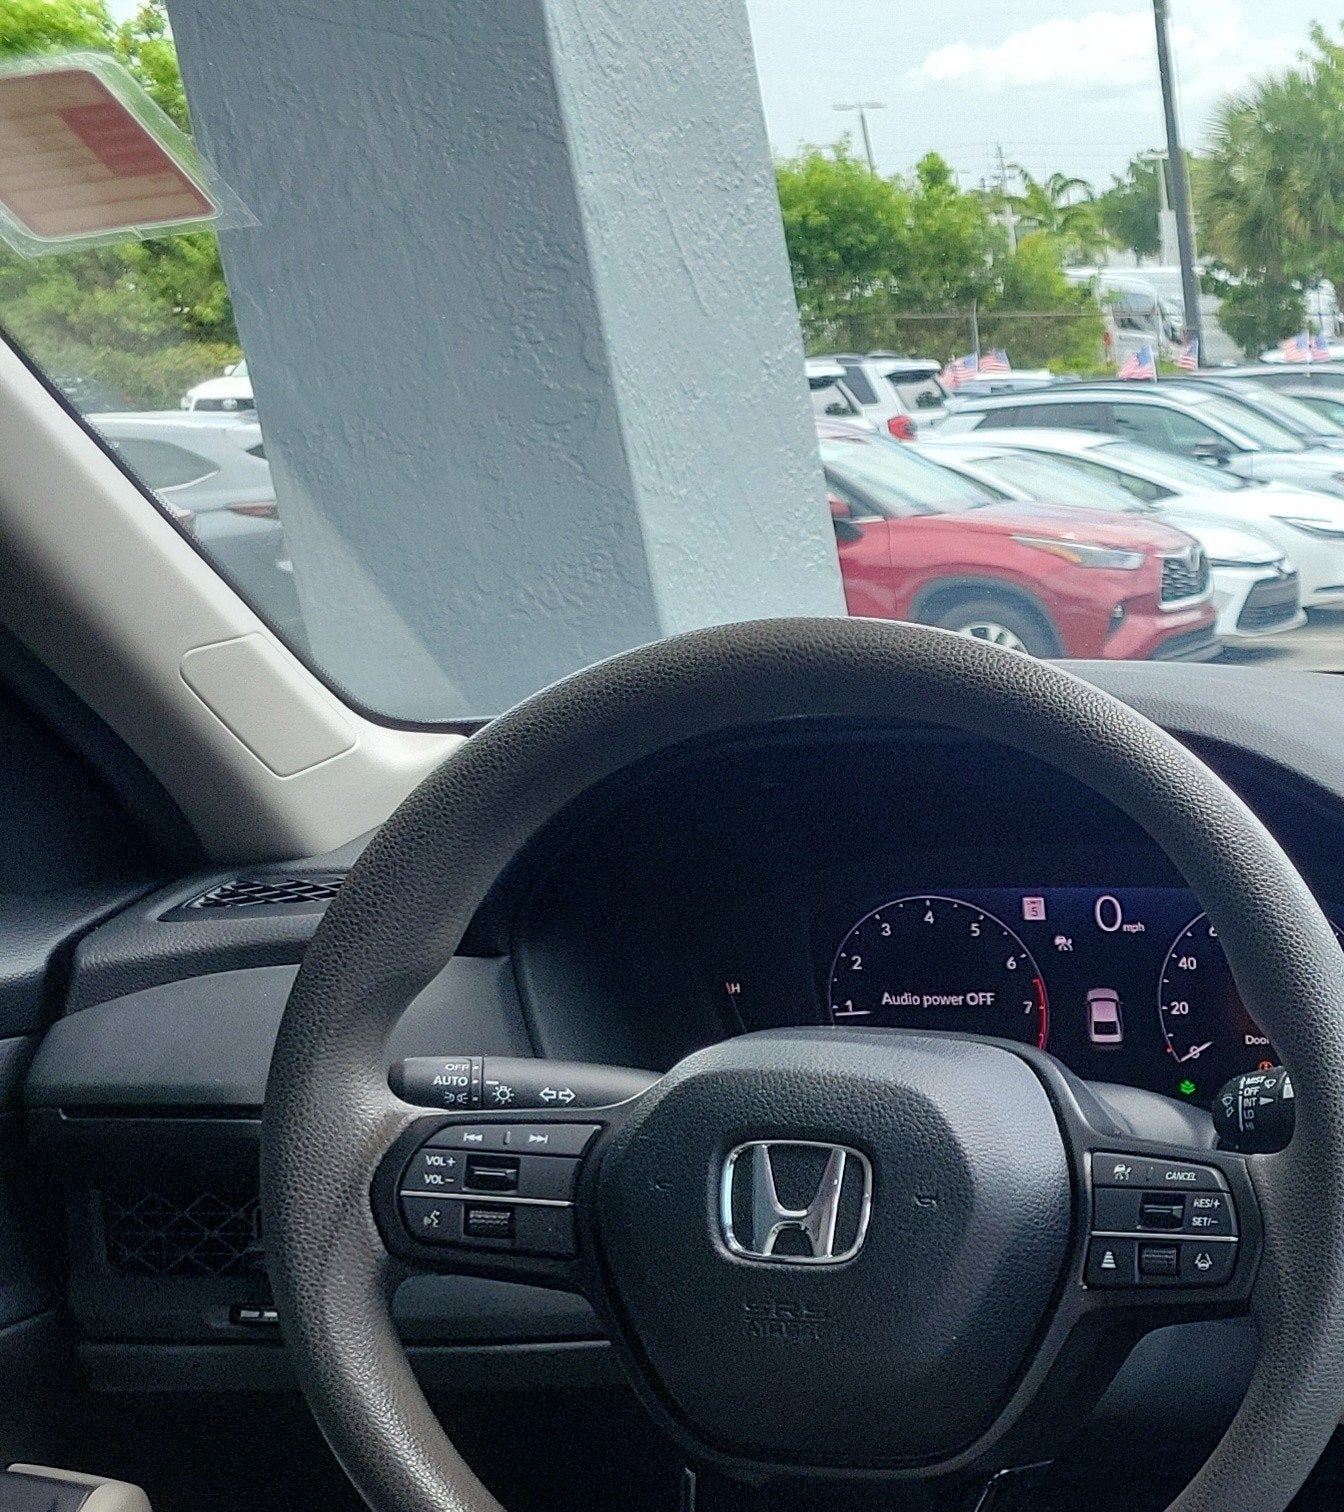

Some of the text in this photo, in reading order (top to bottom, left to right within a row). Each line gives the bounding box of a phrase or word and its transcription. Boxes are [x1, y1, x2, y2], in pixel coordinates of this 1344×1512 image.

[923, 911, 934, 924] 4
[1095, 895, 1145, 934] 0 mph
[881, 923, 892, 936] 3
[970, 924, 981, 937] 5
[851, 957, 863, 970] 2
[1006, 956, 1017, 970] 6
[1178, 957, 1197, 970] 40
[844, 1000, 853, 1012] 1
[881, 992, 995, 1009] Audio power OFF
[1023, 1001, 1033, 1014] 7
[1170, 1001, 1189, 1015] 20
[445, 1063, 469, 1071] OFF
[433, 1076, 468, 1086] AUTO
[1243, 1086, 1260, 1096] OFF
[1243, 1097, 1257, 1107] INT
[1165, 1171, 1197, 1181] CANCEL
